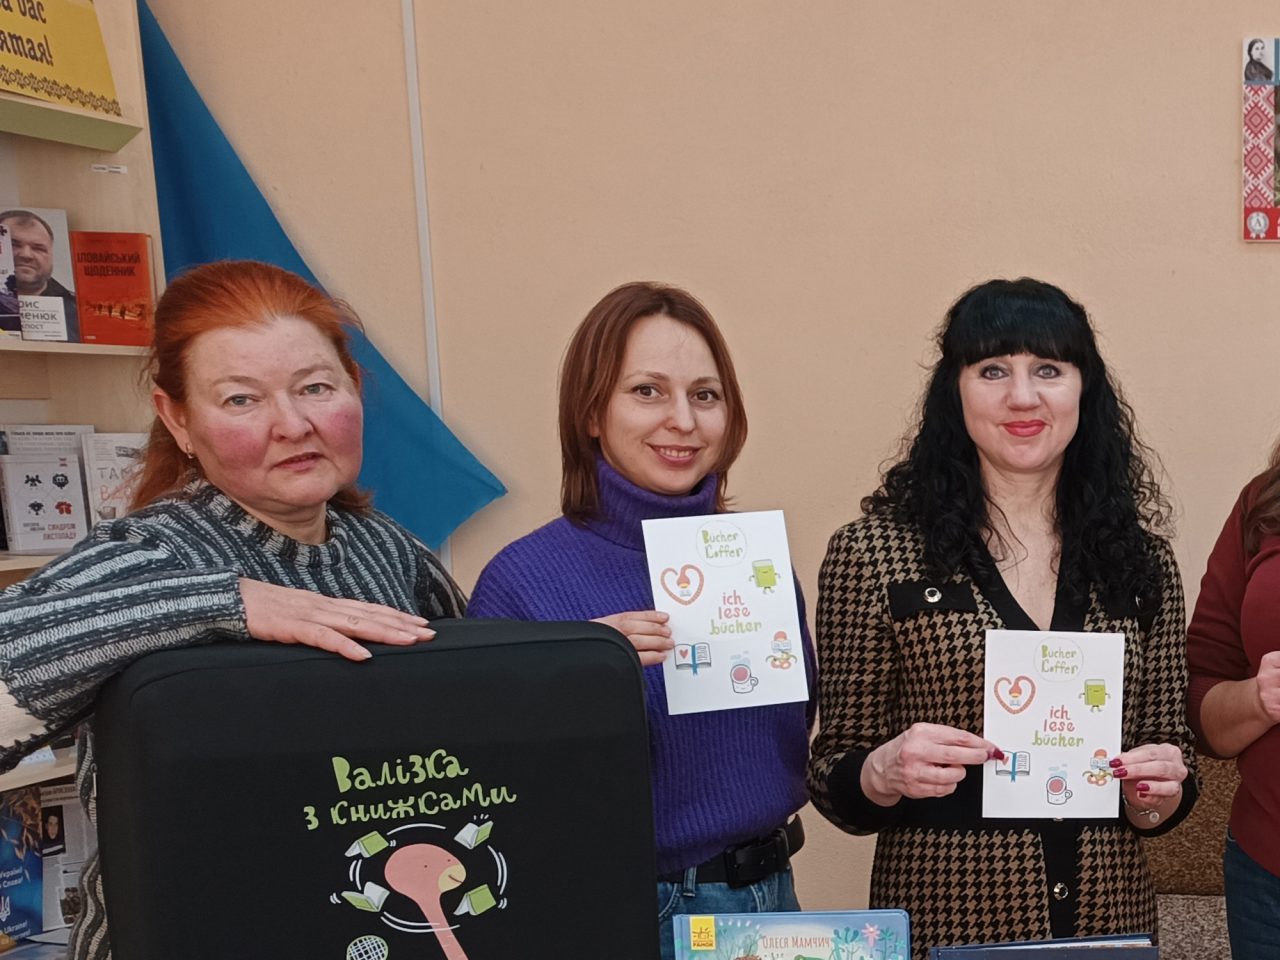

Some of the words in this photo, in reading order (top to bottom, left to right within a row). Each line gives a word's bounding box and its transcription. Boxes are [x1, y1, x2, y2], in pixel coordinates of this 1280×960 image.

[722, 589, 745, 606] ich
[718, 606, 750, 620] lese
[709, 619, 762, 635] bücher
[1049, 705, 1071, 720] ich
[1043, 719, 1075, 732] lese
[1032, 730, 1084, 747] bücher
[332, 748, 470, 793] Валізка
[330, 783, 517, 826] книжками
